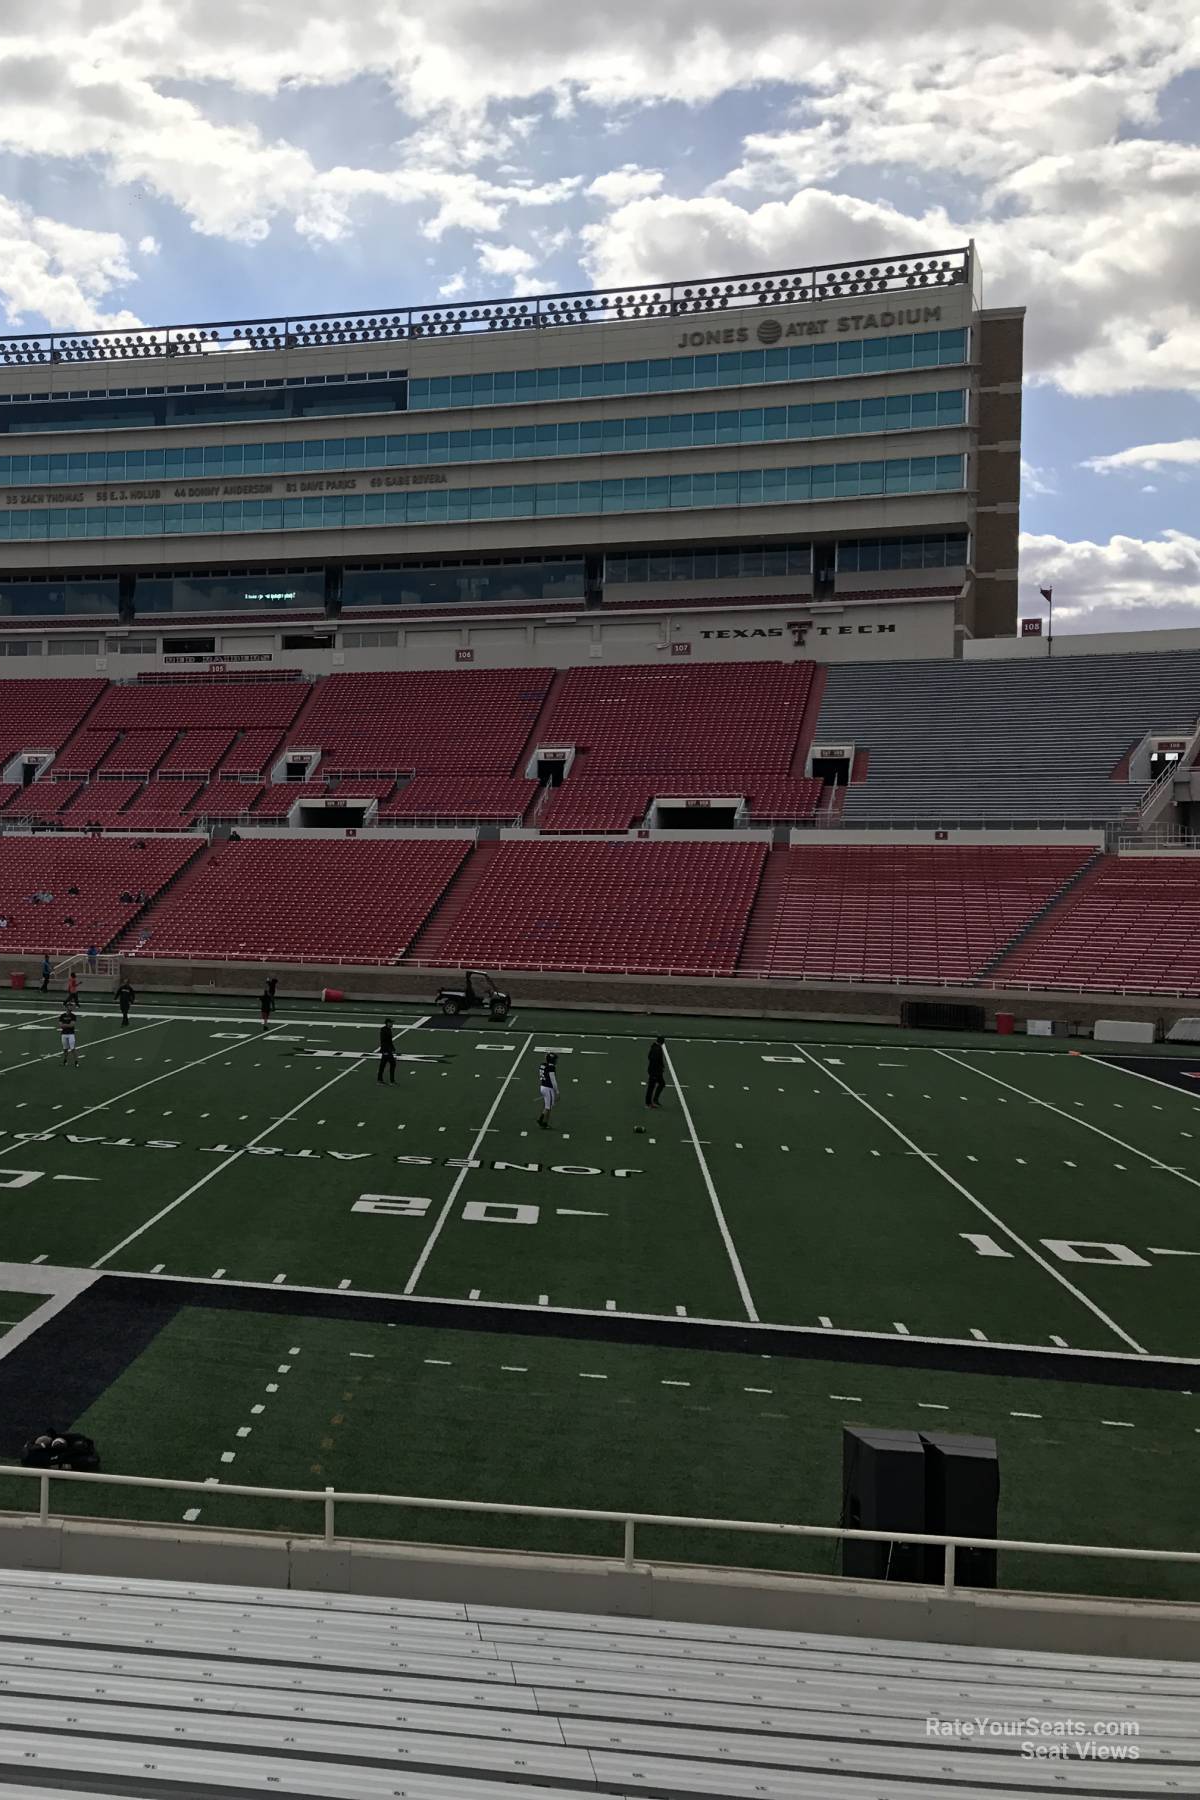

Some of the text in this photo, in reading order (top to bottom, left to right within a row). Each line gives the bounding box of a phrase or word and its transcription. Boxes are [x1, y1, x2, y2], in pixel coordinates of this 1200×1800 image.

[678, 305, 942, 349] JONES AT&T STADIUM
[223, 483, 273, 495] ANDERSON
[300, 481, 324, 492] DAVE
[325, 479, 357, 490] PARKS
[700, 627, 783, 639] TEXAS
[817, 624, 896, 635] TECH
[199, 1143, 373, 1161] AT&T
[396, 1155, 646, 1178] JONES
[350, 1193, 541, 1224] 20
[958, 1233, 1152, 1267] 10
